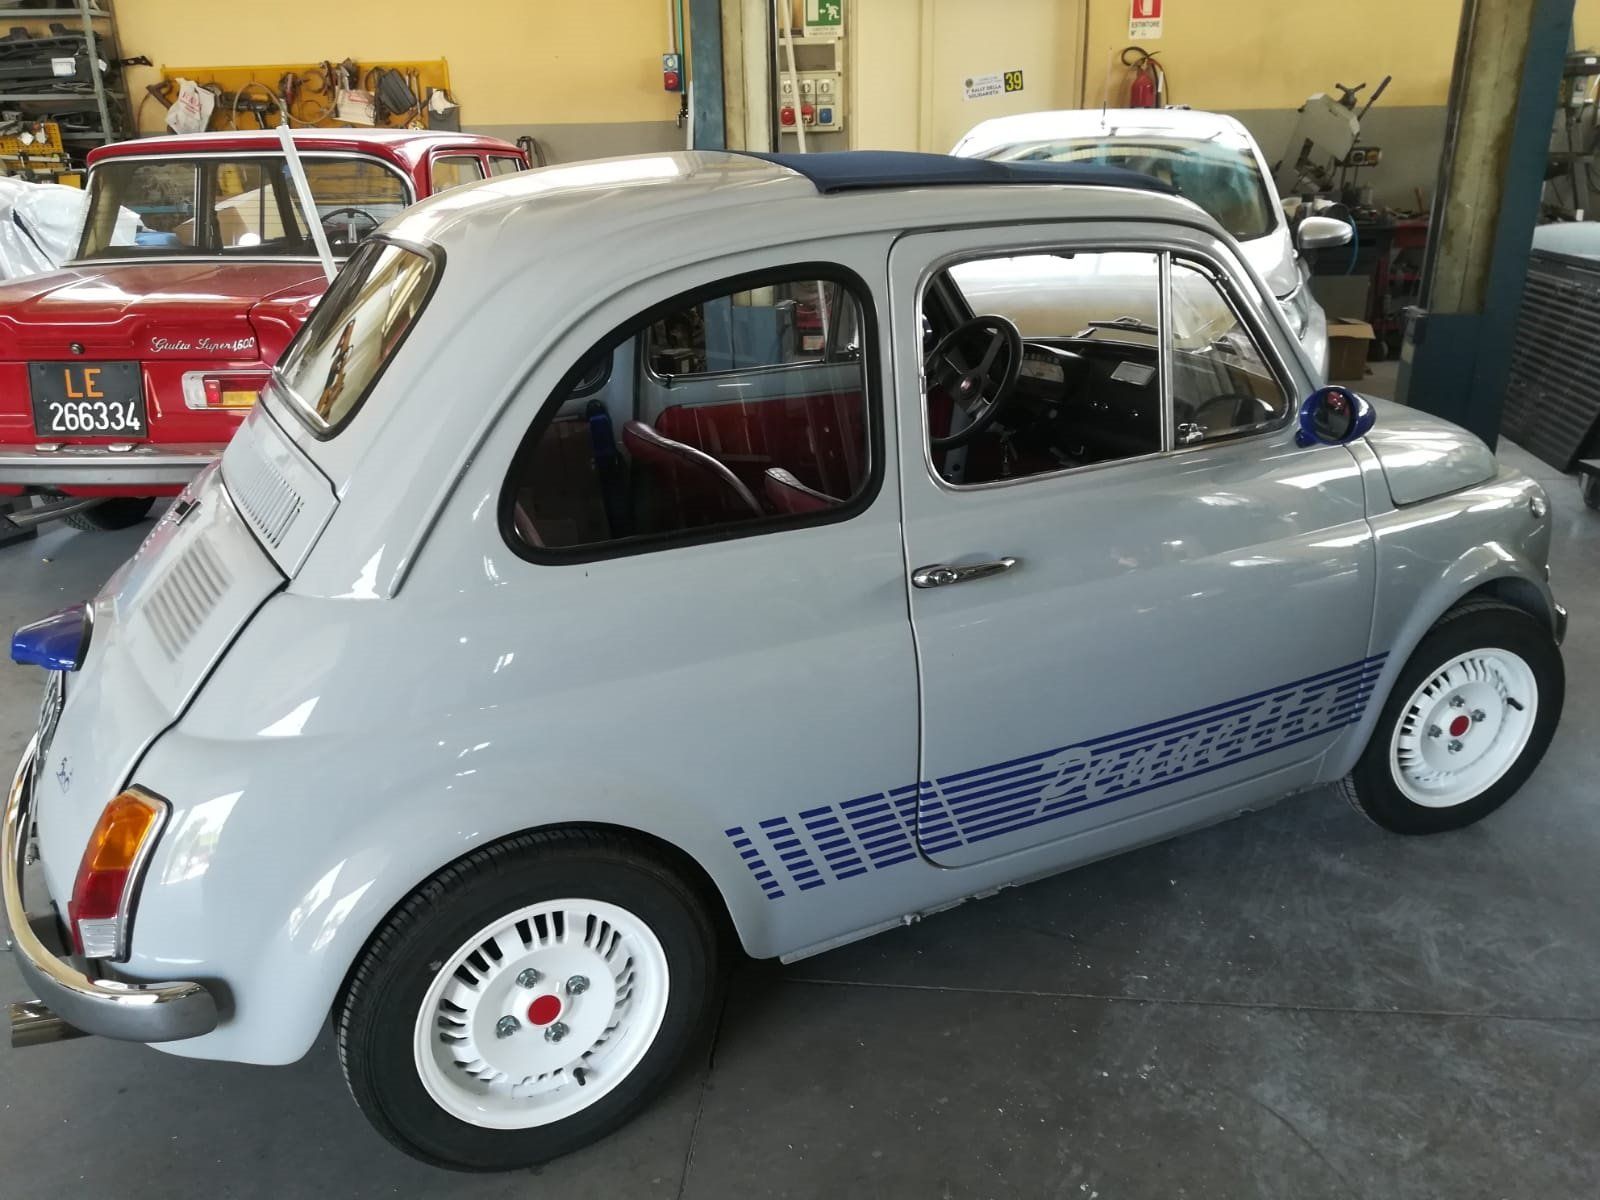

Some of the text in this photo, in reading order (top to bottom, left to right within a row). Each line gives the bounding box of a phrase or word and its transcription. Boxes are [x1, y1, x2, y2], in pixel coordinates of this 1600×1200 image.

[1131, 20, 1160, 28] ESTINTORE
[1005, 72, 1023, 91] 39
[150, 336, 255, 352] Giulia Super 1600
[64, 368, 104, 399] LE
[49, 401, 141, 431] 266334
